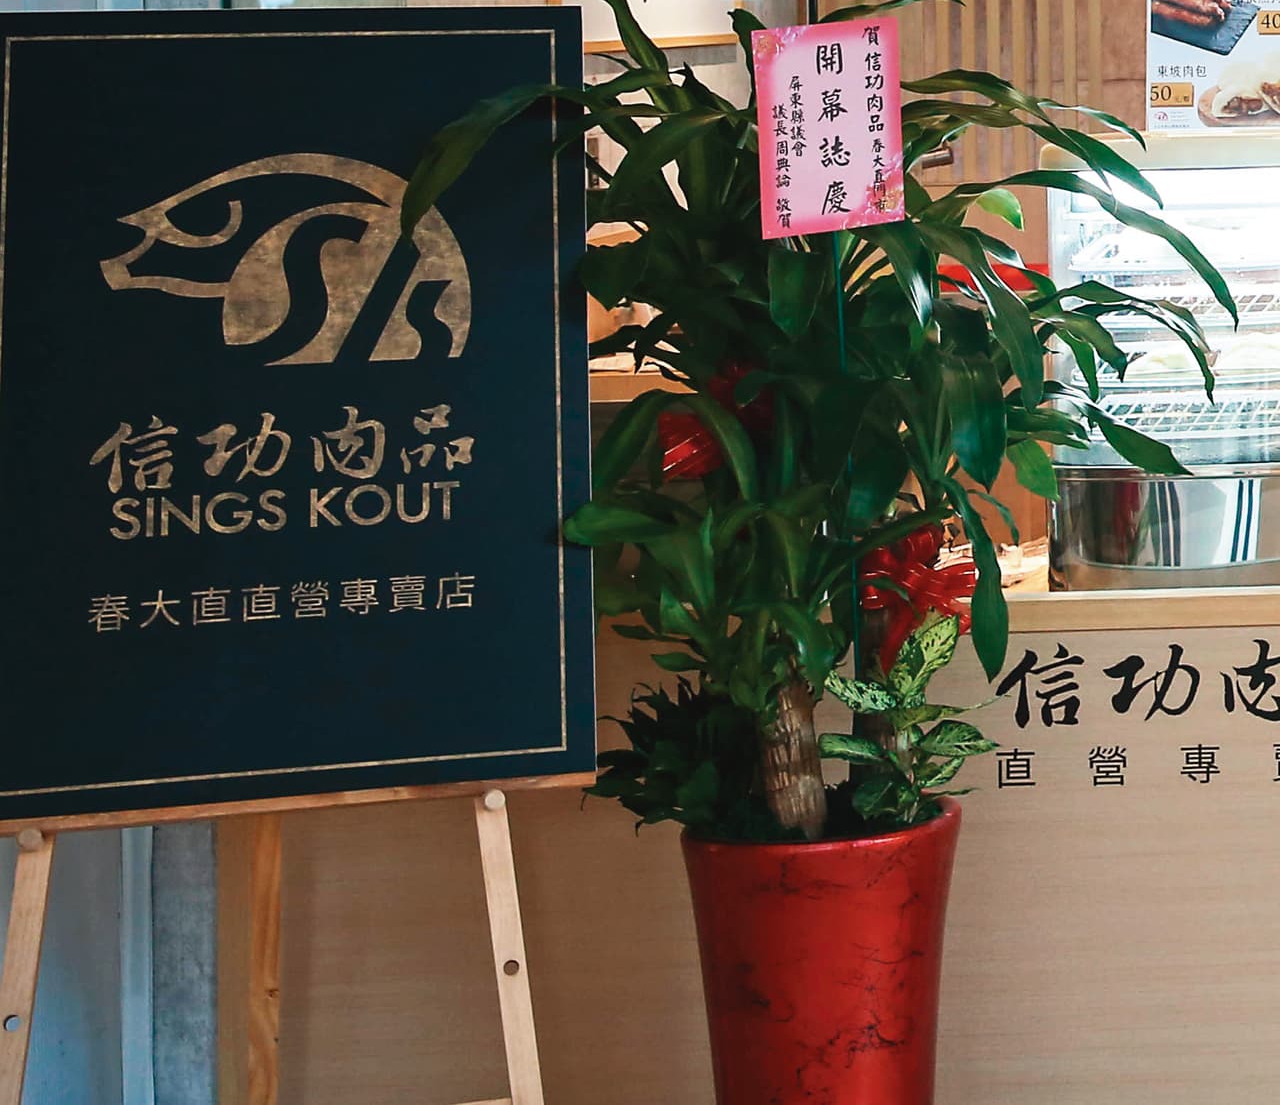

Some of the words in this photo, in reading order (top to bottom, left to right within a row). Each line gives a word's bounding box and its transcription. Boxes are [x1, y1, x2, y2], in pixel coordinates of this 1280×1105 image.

[864, 52, 885, 133] 信功肉品
[1150, 85, 1172, 101] 50
[1157, 65, 1208, 78] 東坡肉包
[815, 42, 852, 216] 開幕誌慶
[88, 404, 476, 495] 信功肉品
[109, 490, 288, 541] SINGS
[310, 480, 461, 528] KOUT
[87, 572, 477, 633] 春大直直營專賣店
